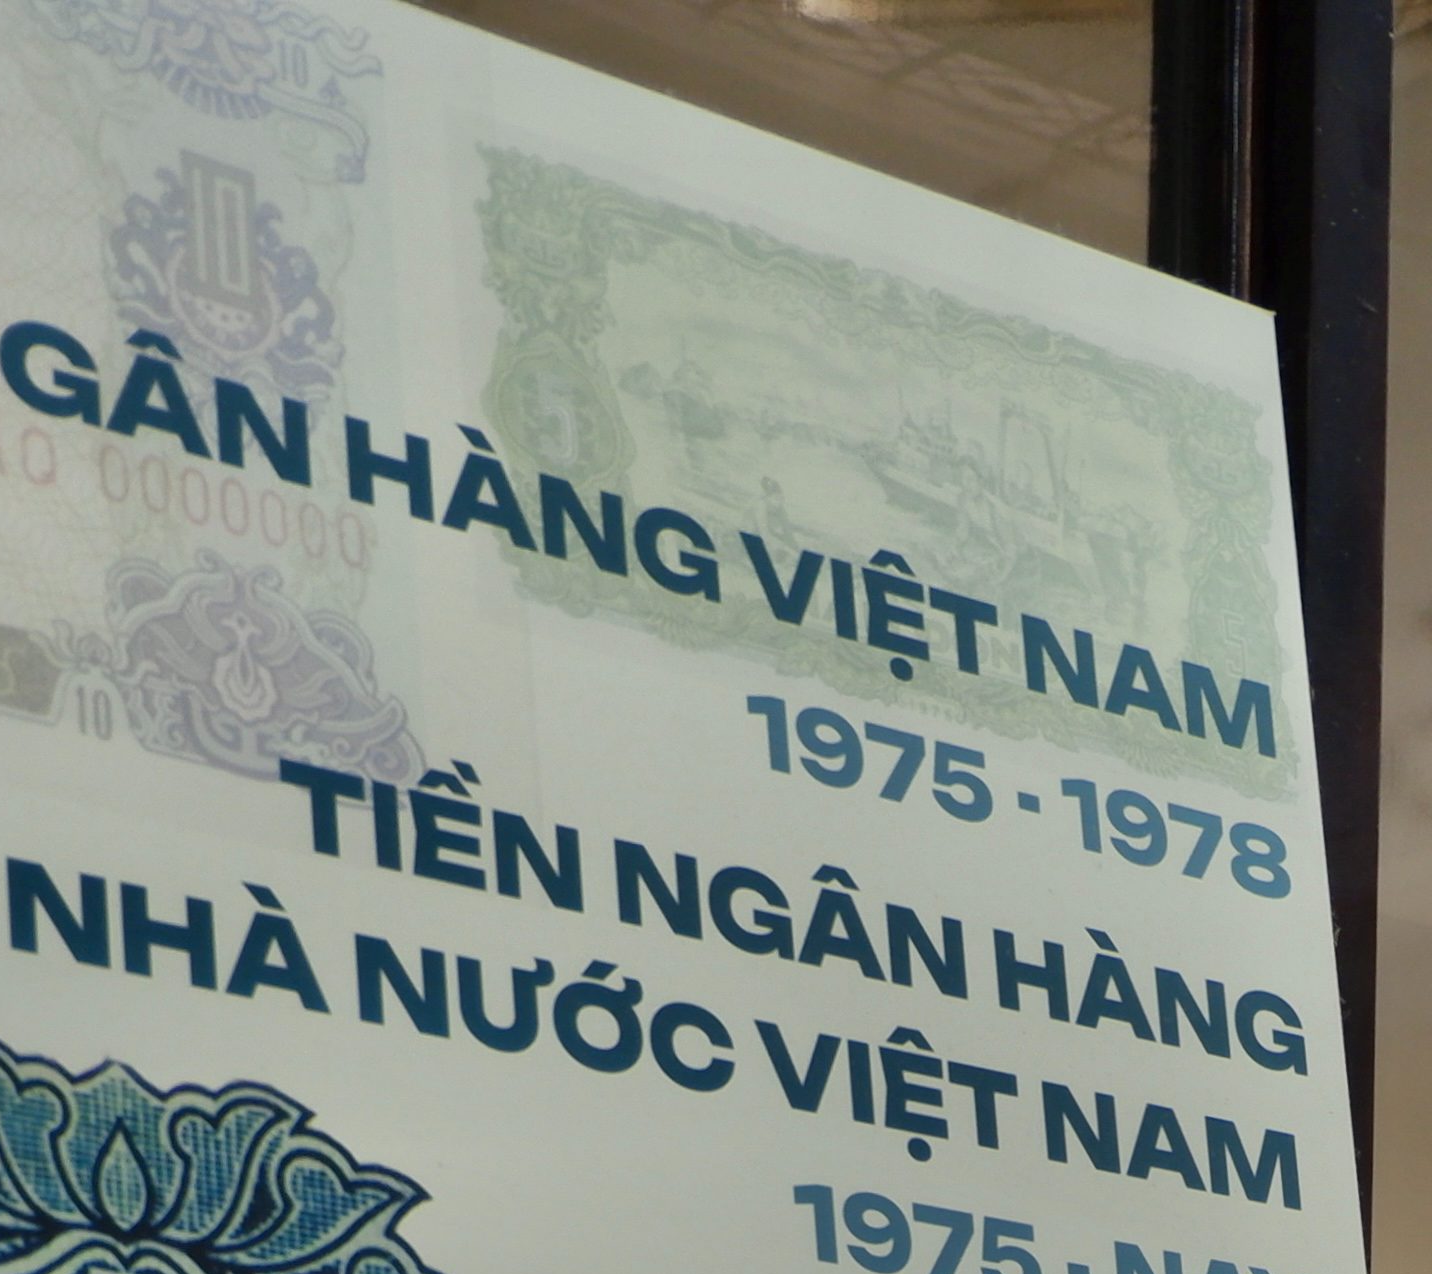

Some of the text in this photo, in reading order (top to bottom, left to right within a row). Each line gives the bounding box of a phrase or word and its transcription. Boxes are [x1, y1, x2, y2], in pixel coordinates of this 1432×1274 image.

[345, 416, 721, 603] HÀNG
[739, 531, 998, 681] VIỆT
[1021, 614, 1270, 755] NAM
[278, 756, 1308, 1076] TIỀN NGÂN HÀNG
[747, 696, 992, 821] 1975
[1061, 778, 1291, 900] 1978
[6, 857, 1301, 1210] NHÀ NƯỚC VIỆT NAM
